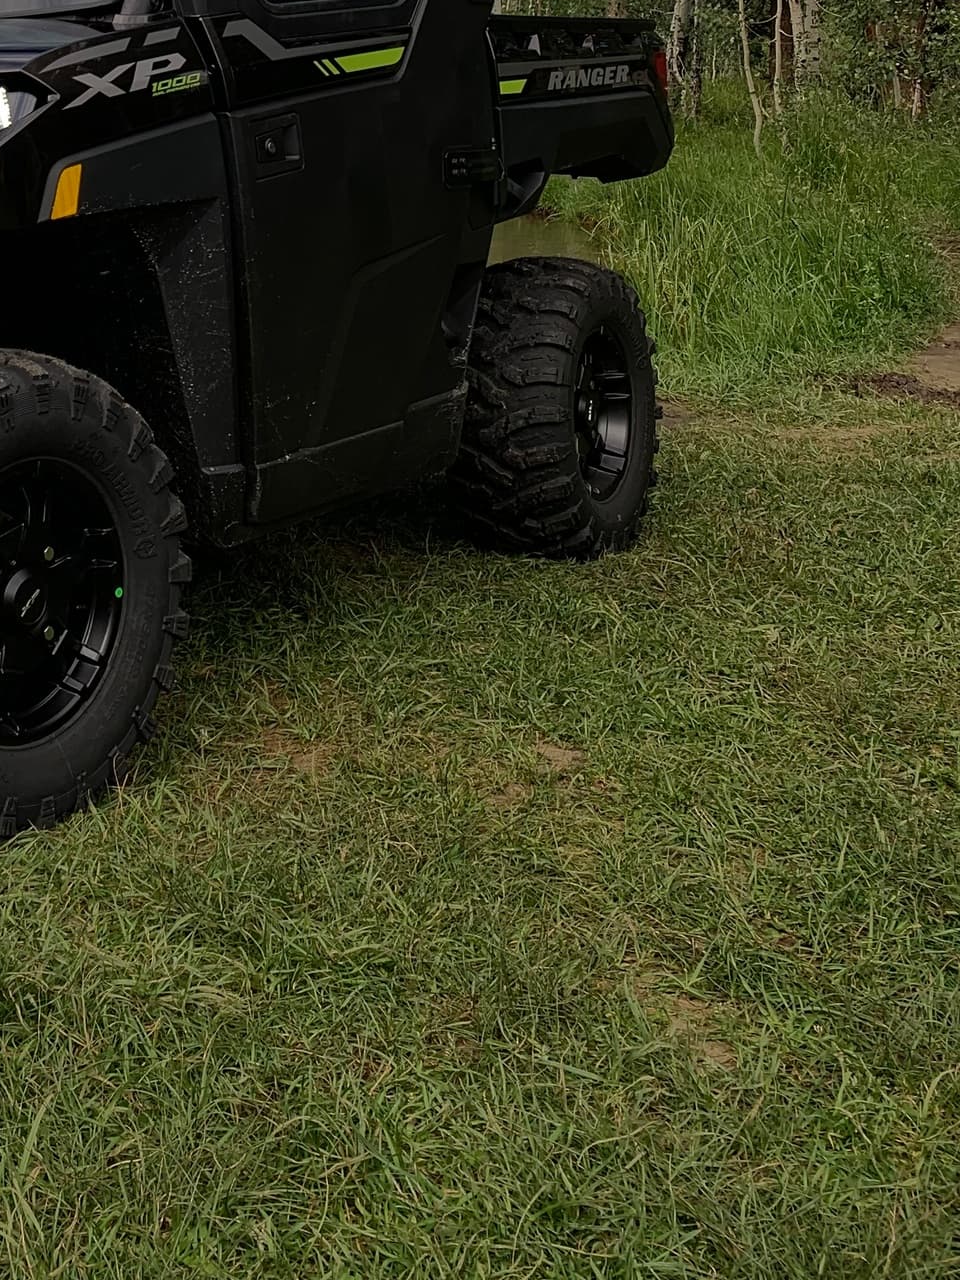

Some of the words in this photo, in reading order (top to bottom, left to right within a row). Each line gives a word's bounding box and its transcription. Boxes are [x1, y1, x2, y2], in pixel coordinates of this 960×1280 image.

[61, 52, 188, 110] XP
[152, 72, 201, 93] 1000
[547, 65, 630, 91] RANGER
